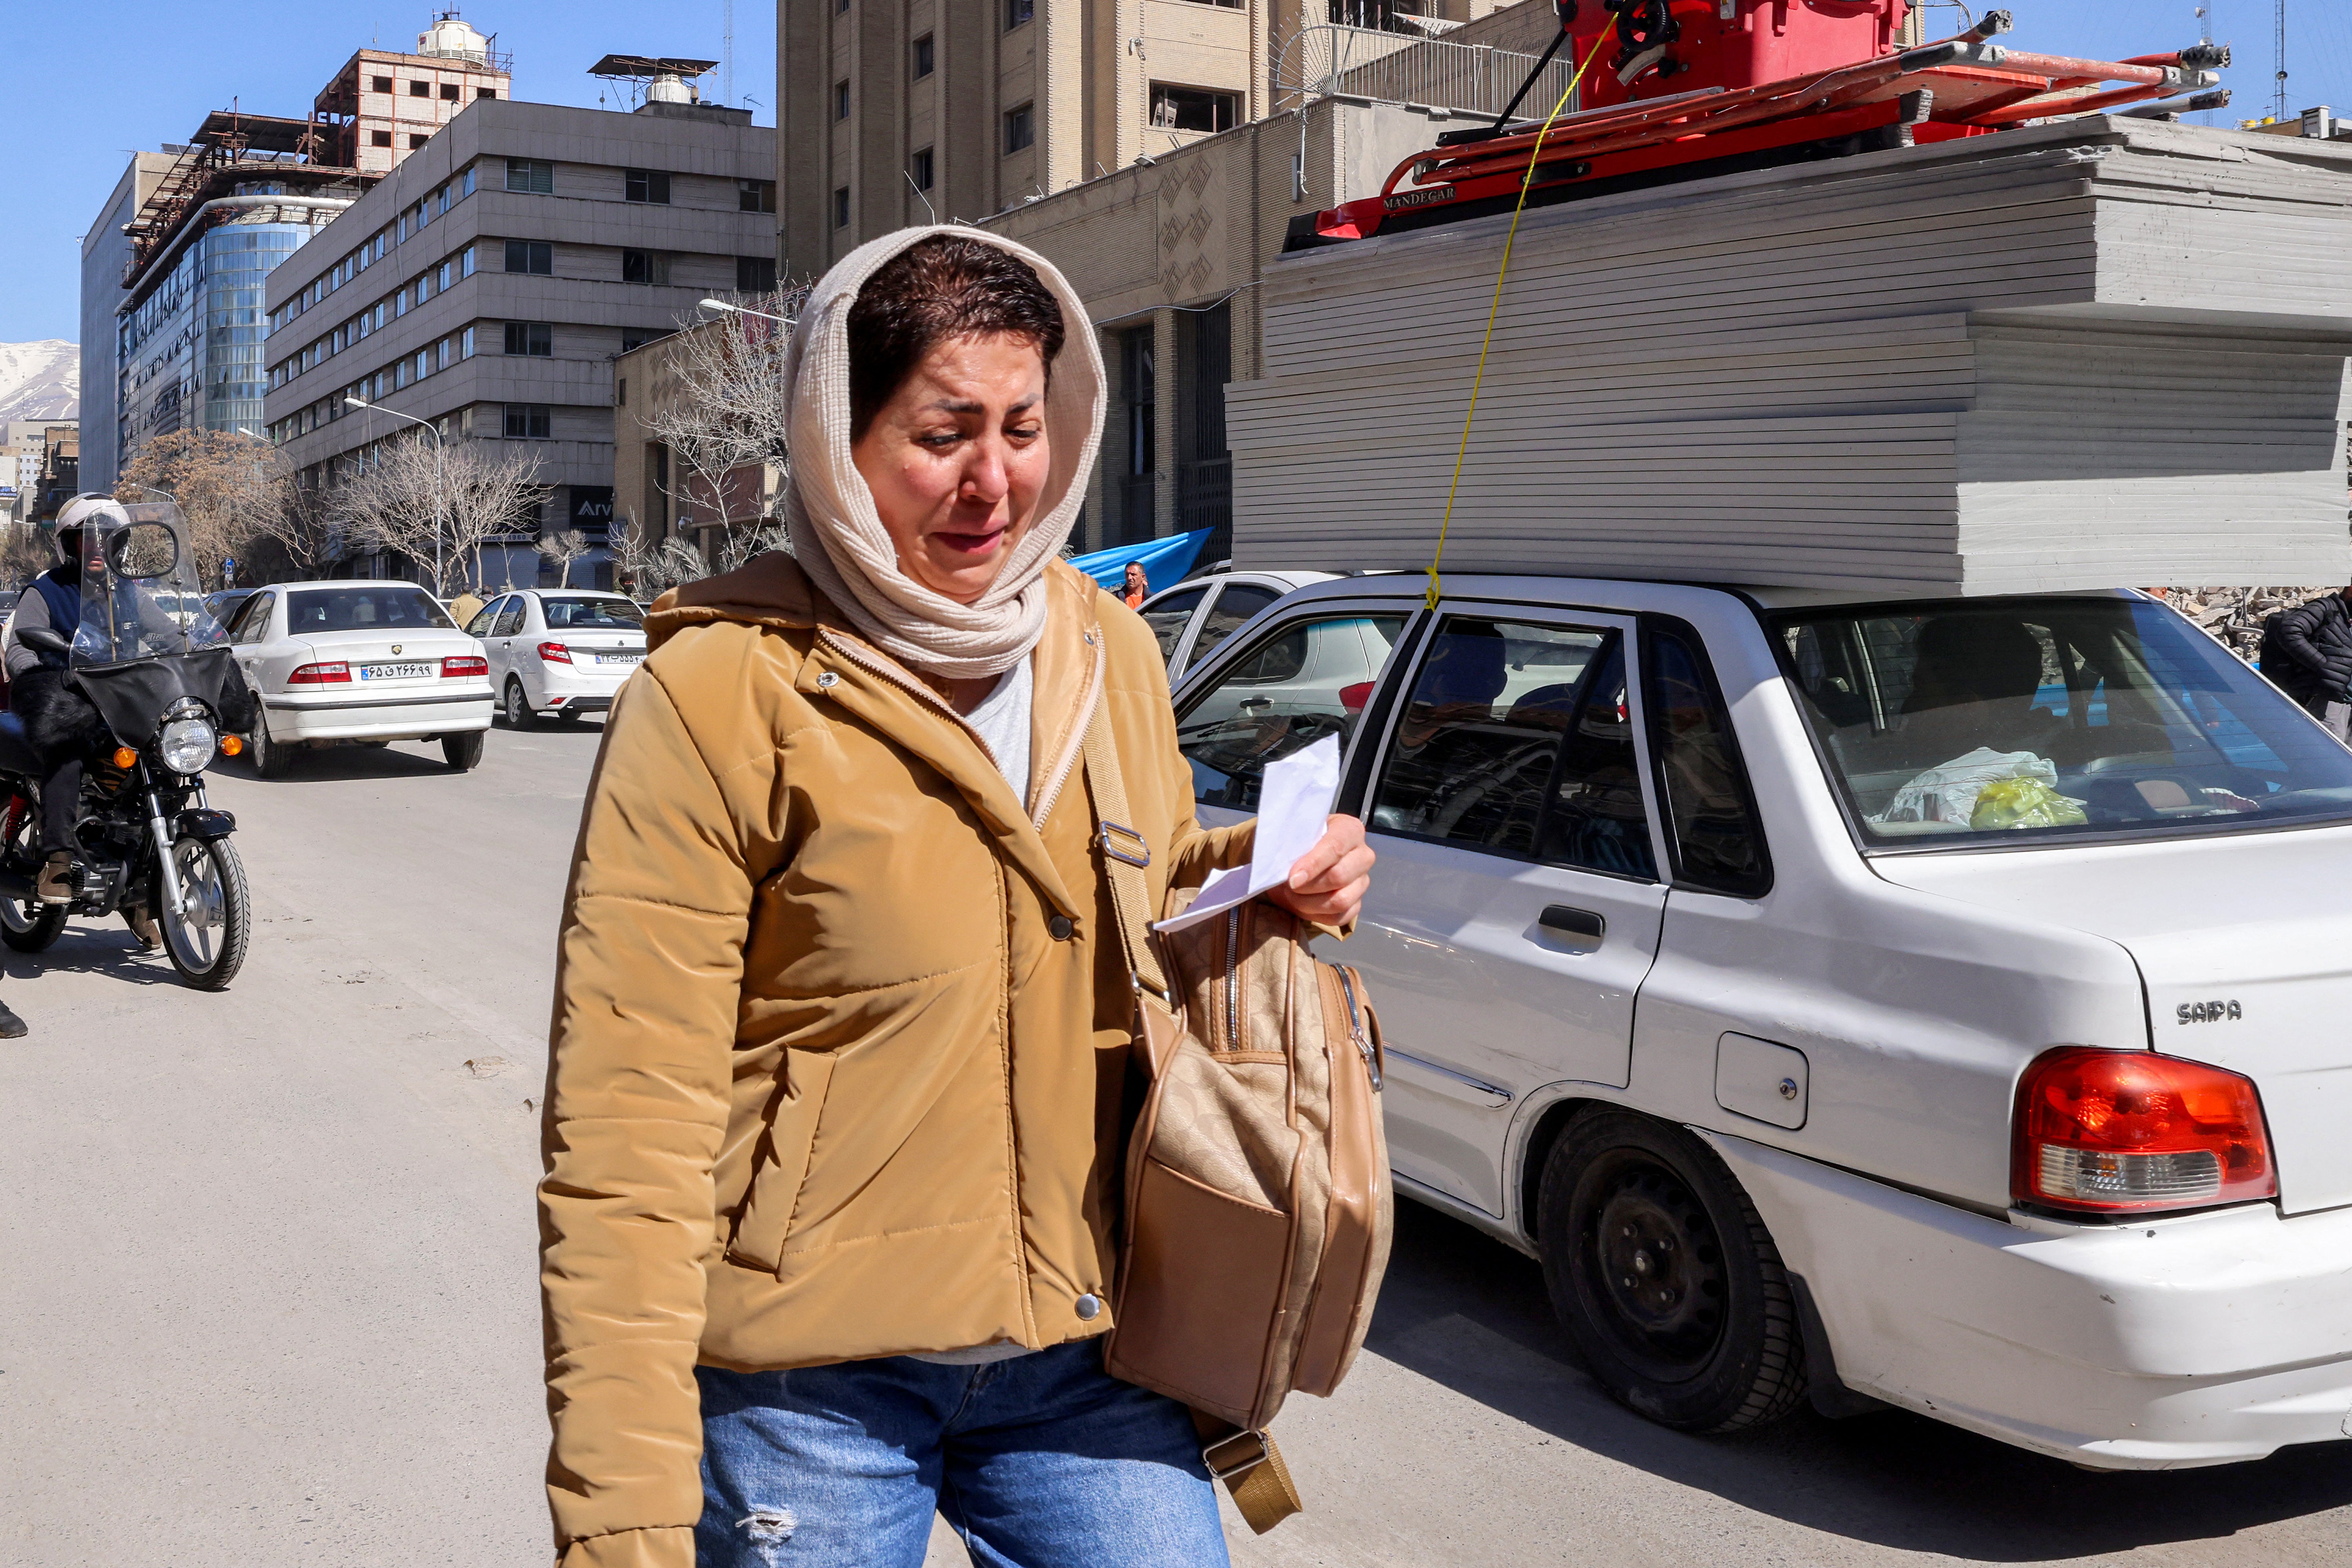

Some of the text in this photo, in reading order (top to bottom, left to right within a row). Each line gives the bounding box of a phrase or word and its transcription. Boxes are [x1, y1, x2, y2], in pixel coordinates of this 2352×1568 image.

[1384, 188, 1454, 208] MANDEGAR
[418, 666, 431, 675] ۹۹
[2177, 999, 2241, 1025] SAIPA
